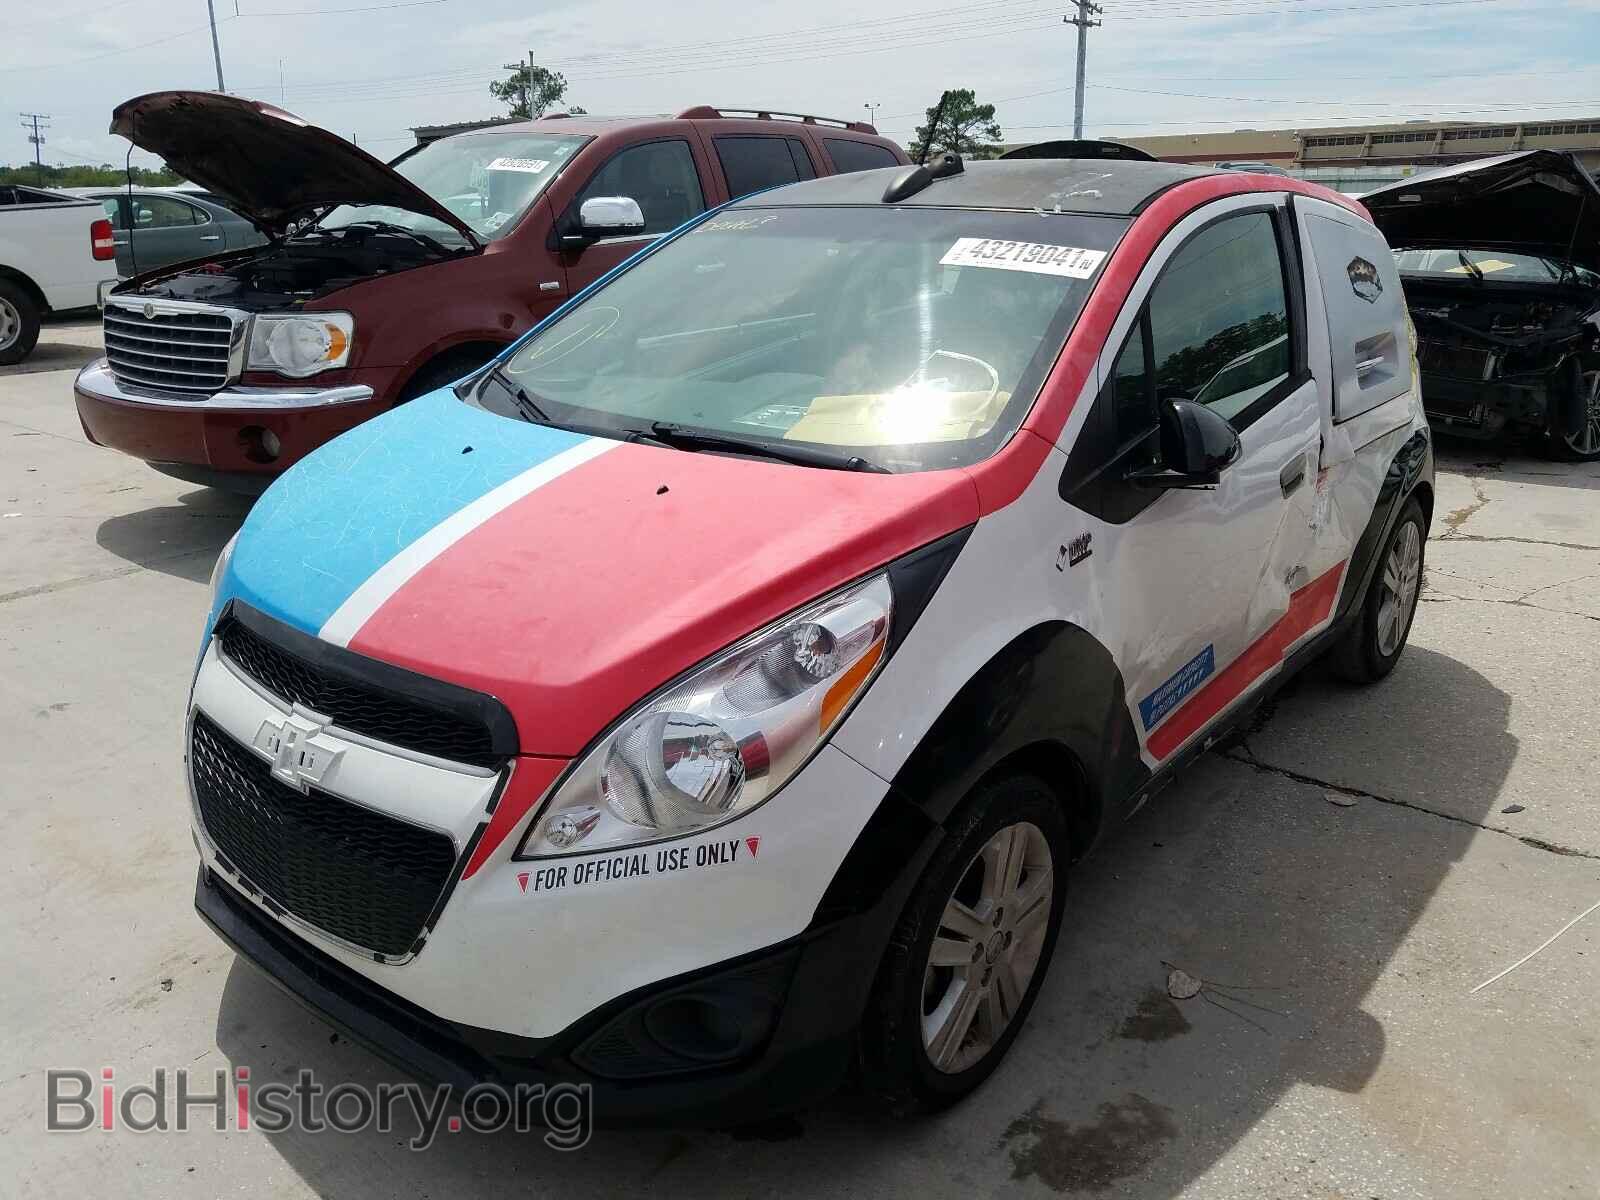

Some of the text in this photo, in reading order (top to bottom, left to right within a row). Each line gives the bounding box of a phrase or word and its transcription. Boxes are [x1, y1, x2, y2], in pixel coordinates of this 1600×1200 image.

[969, 239, 1087, 268] 43219041
[534, 839, 740, 892] FOR OFFICIAL USE ONLY
